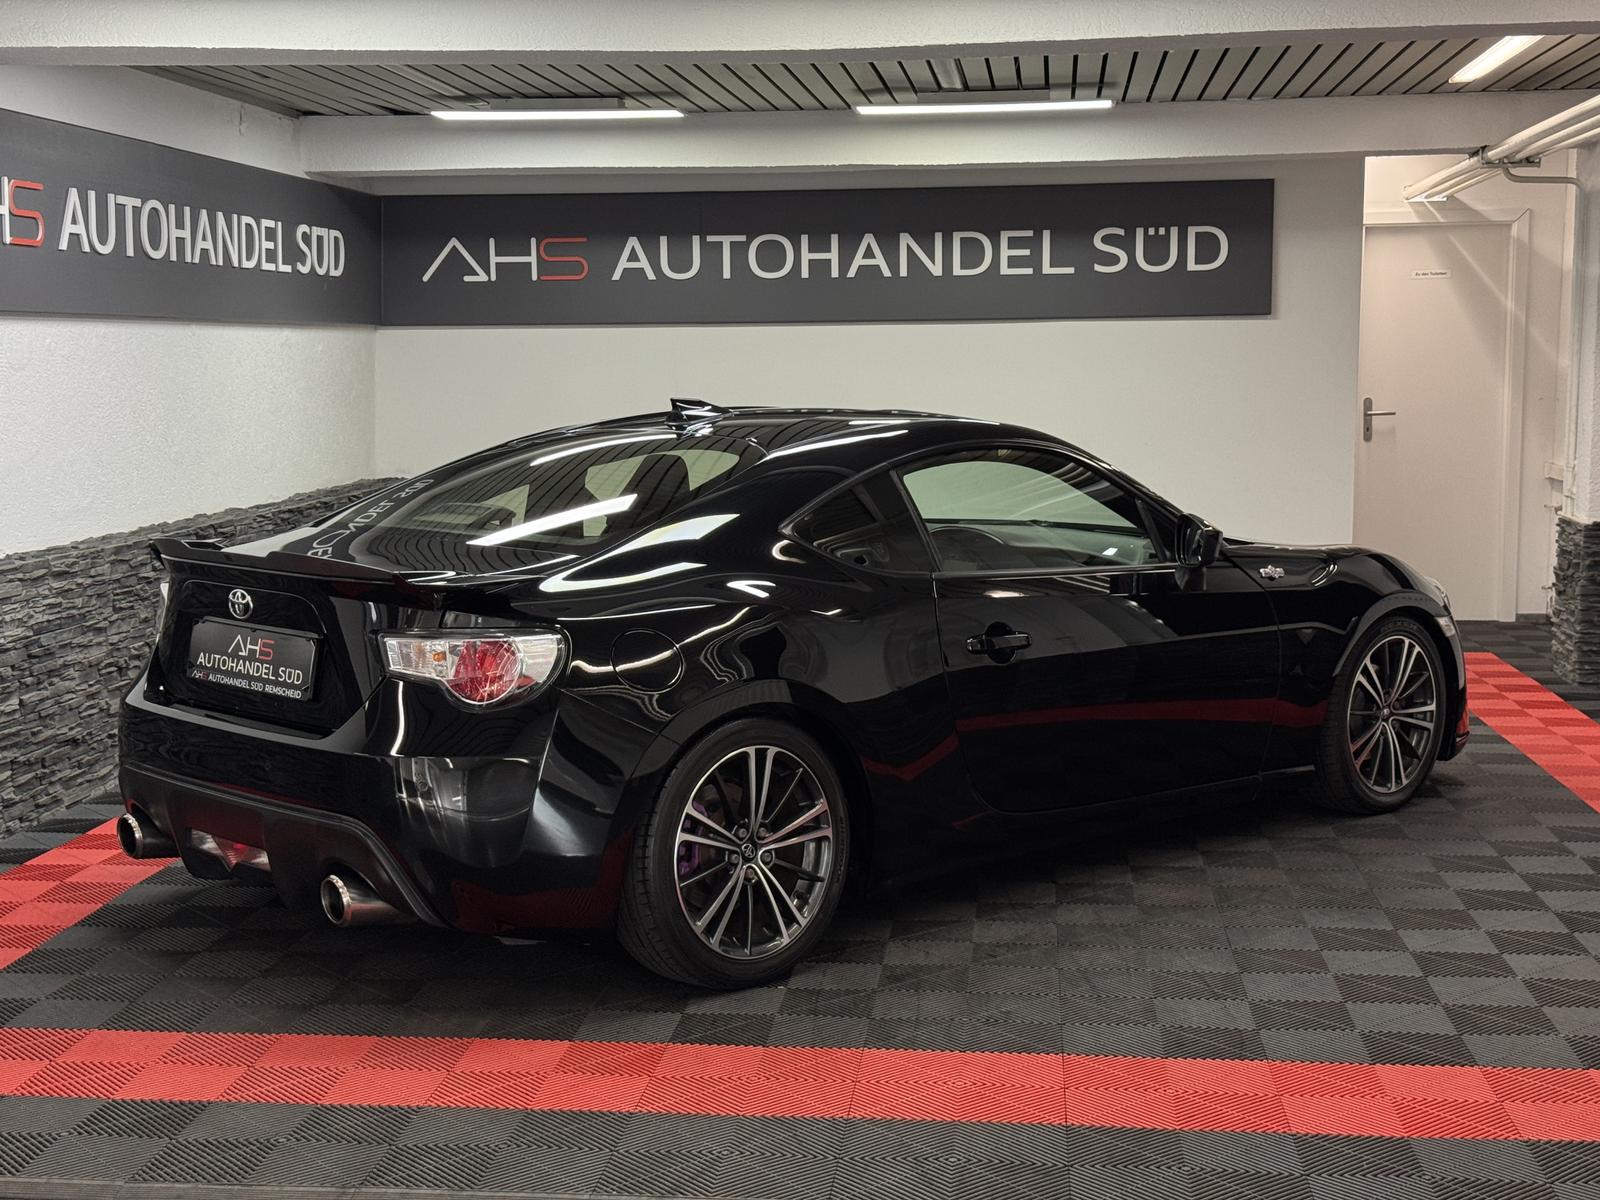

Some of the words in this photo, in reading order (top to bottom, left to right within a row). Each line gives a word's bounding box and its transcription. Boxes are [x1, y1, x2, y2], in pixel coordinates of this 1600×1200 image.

[58, 187, 293, 273] AUTOHANDEL
[296, 223, 346, 277] SÜD
[422, 236, 589, 282] AHS
[611, 229, 1075, 281] AUTOHANDEL
[1093, 225, 1230, 274] SÜD
[228, 634, 275, 660] AHS
[197, 652, 275, 680] AUTOHANDEL
[278, 667, 303, 685] SÜD
[208, 673, 250, 690] AUTOHANDEL
[265, 684, 302, 698] REMSCHEID
